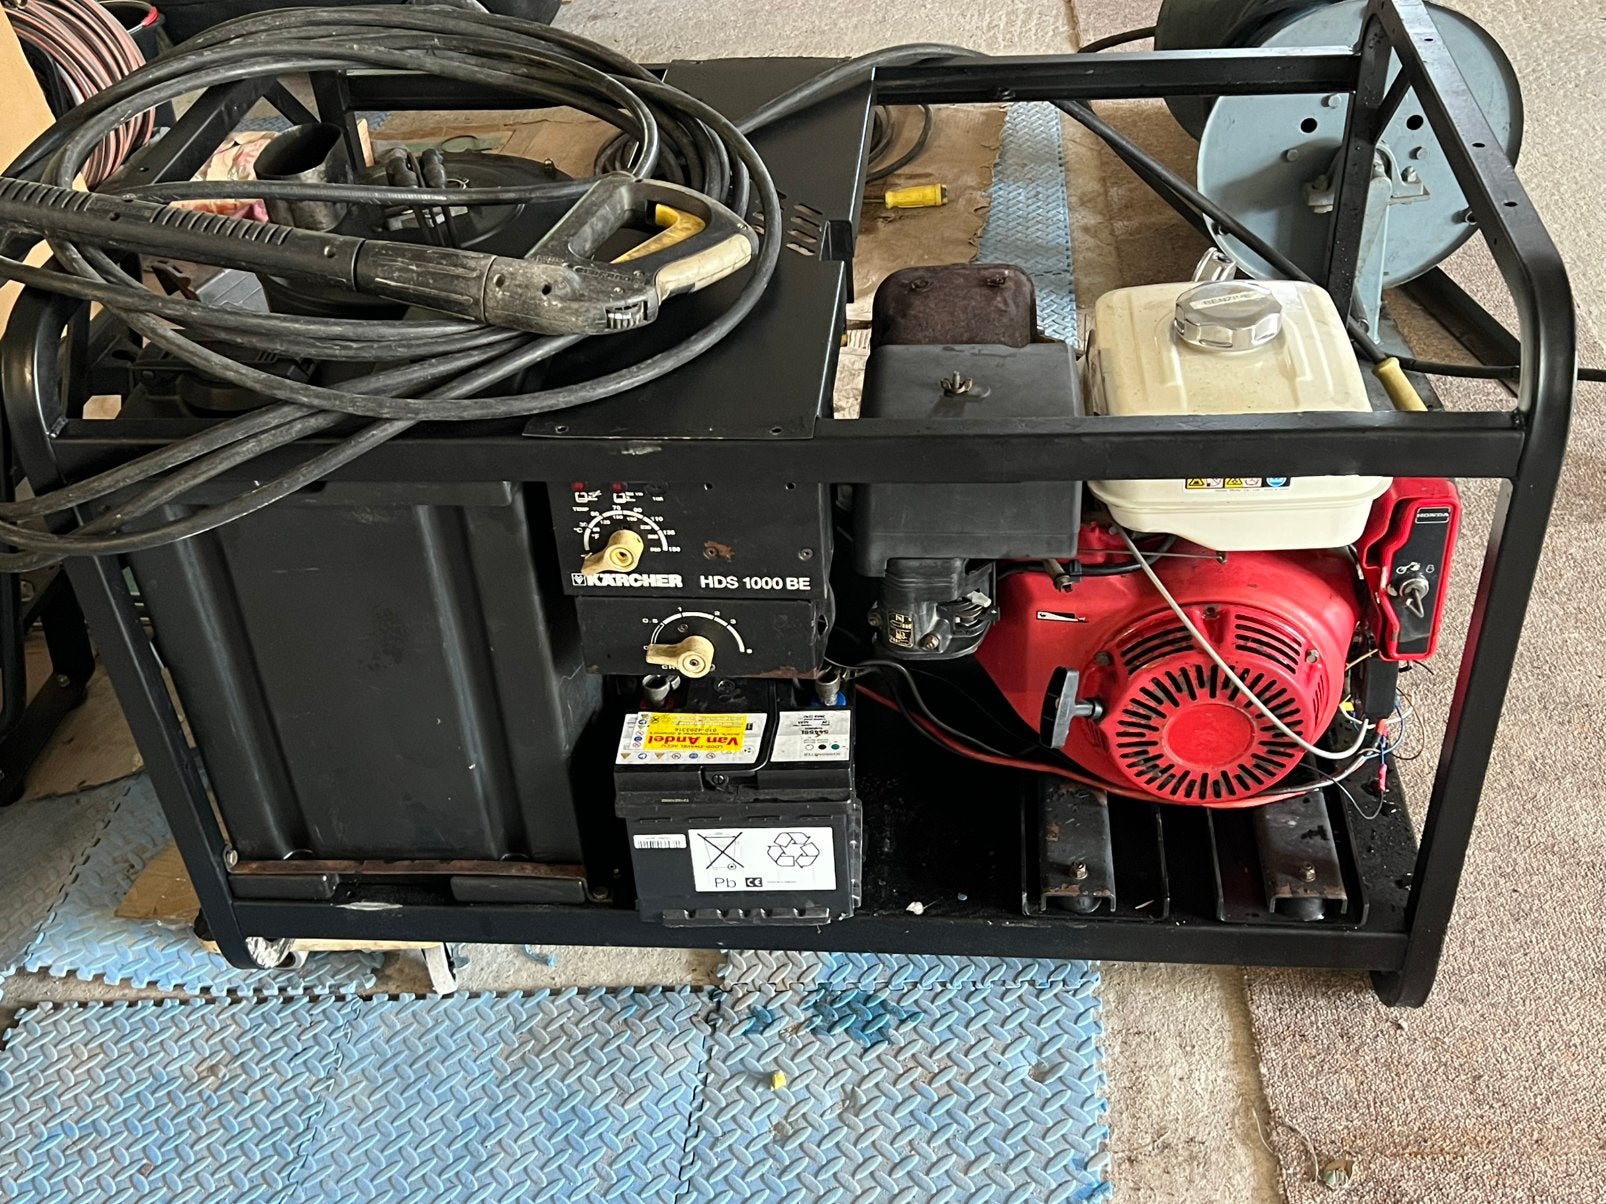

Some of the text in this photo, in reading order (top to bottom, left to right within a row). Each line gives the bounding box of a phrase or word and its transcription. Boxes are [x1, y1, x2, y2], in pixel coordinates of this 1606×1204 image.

[700, 575, 811, 590] HDS 1000 BE
[648, 735, 739, 746] Van Andel
[714, 877, 737, 888] Pb
